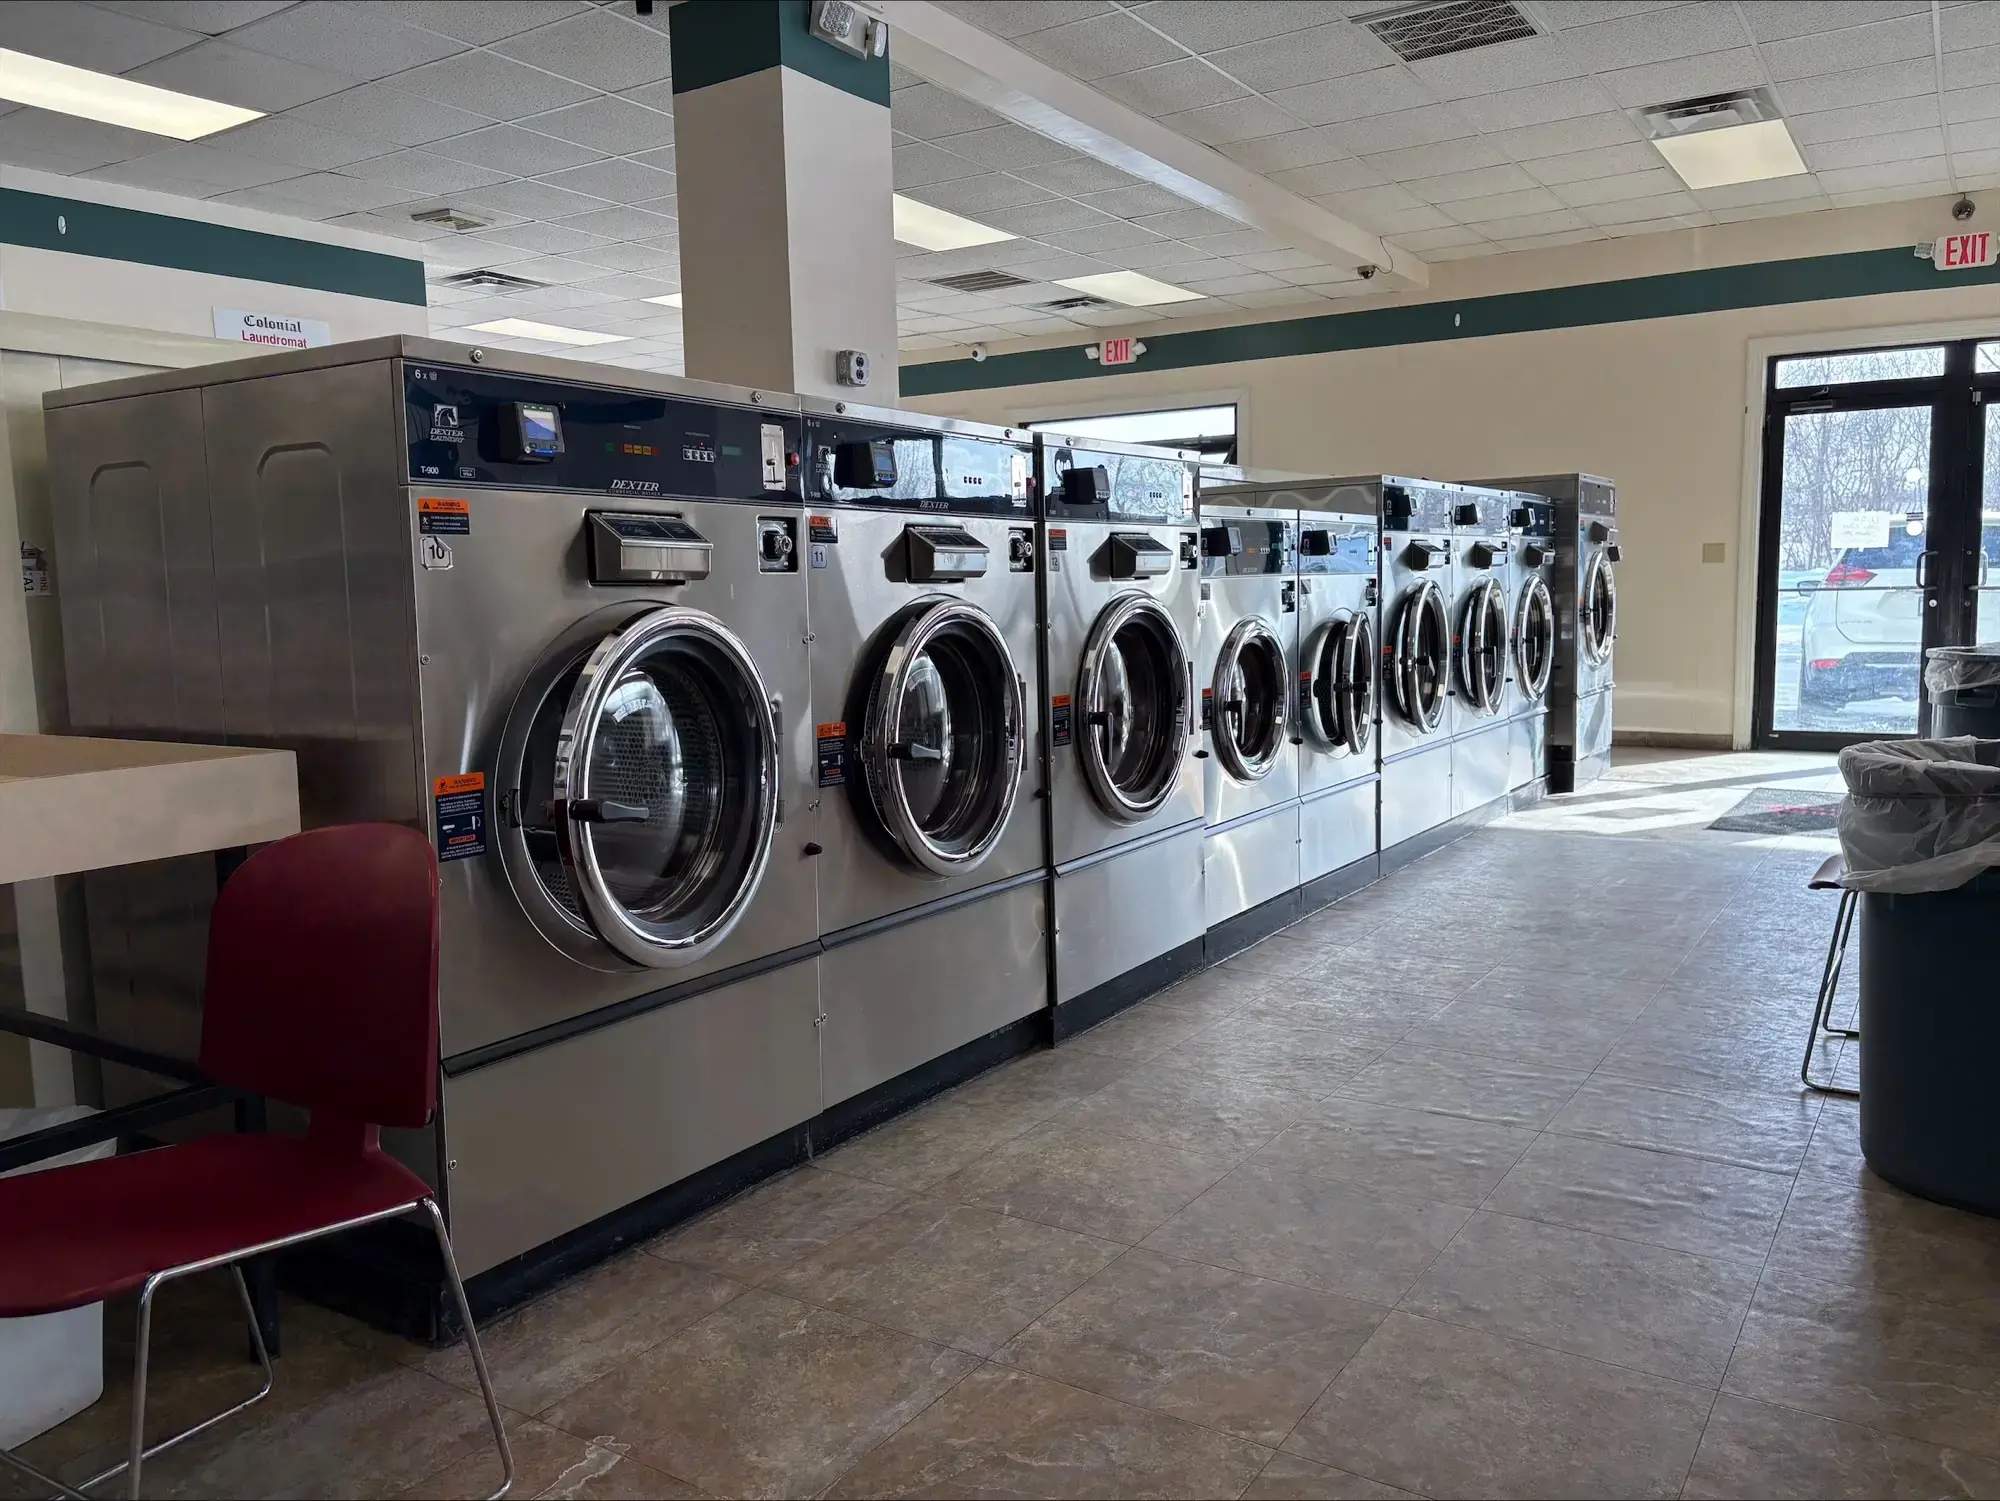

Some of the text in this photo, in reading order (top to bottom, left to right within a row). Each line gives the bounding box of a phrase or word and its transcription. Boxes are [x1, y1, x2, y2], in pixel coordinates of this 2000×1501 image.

[1945, 233, 1990, 266] EXIT
[243, 314, 302, 333] Colonial
[241, 330, 307, 349] Laundromat
[1105, 338, 1130, 364] EXIT
[414, 369, 421, 379] 6
[430, 427, 464, 437] DEXTER
[420, 465, 439, 475] T-900
[610, 479, 660, 491] DEXTER
[919, 501, 949, 509] DEXTER
[429, 544, 445, 560] 10
[814, 551, 824, 562] 11
[23, 577, 34, 592] A1
